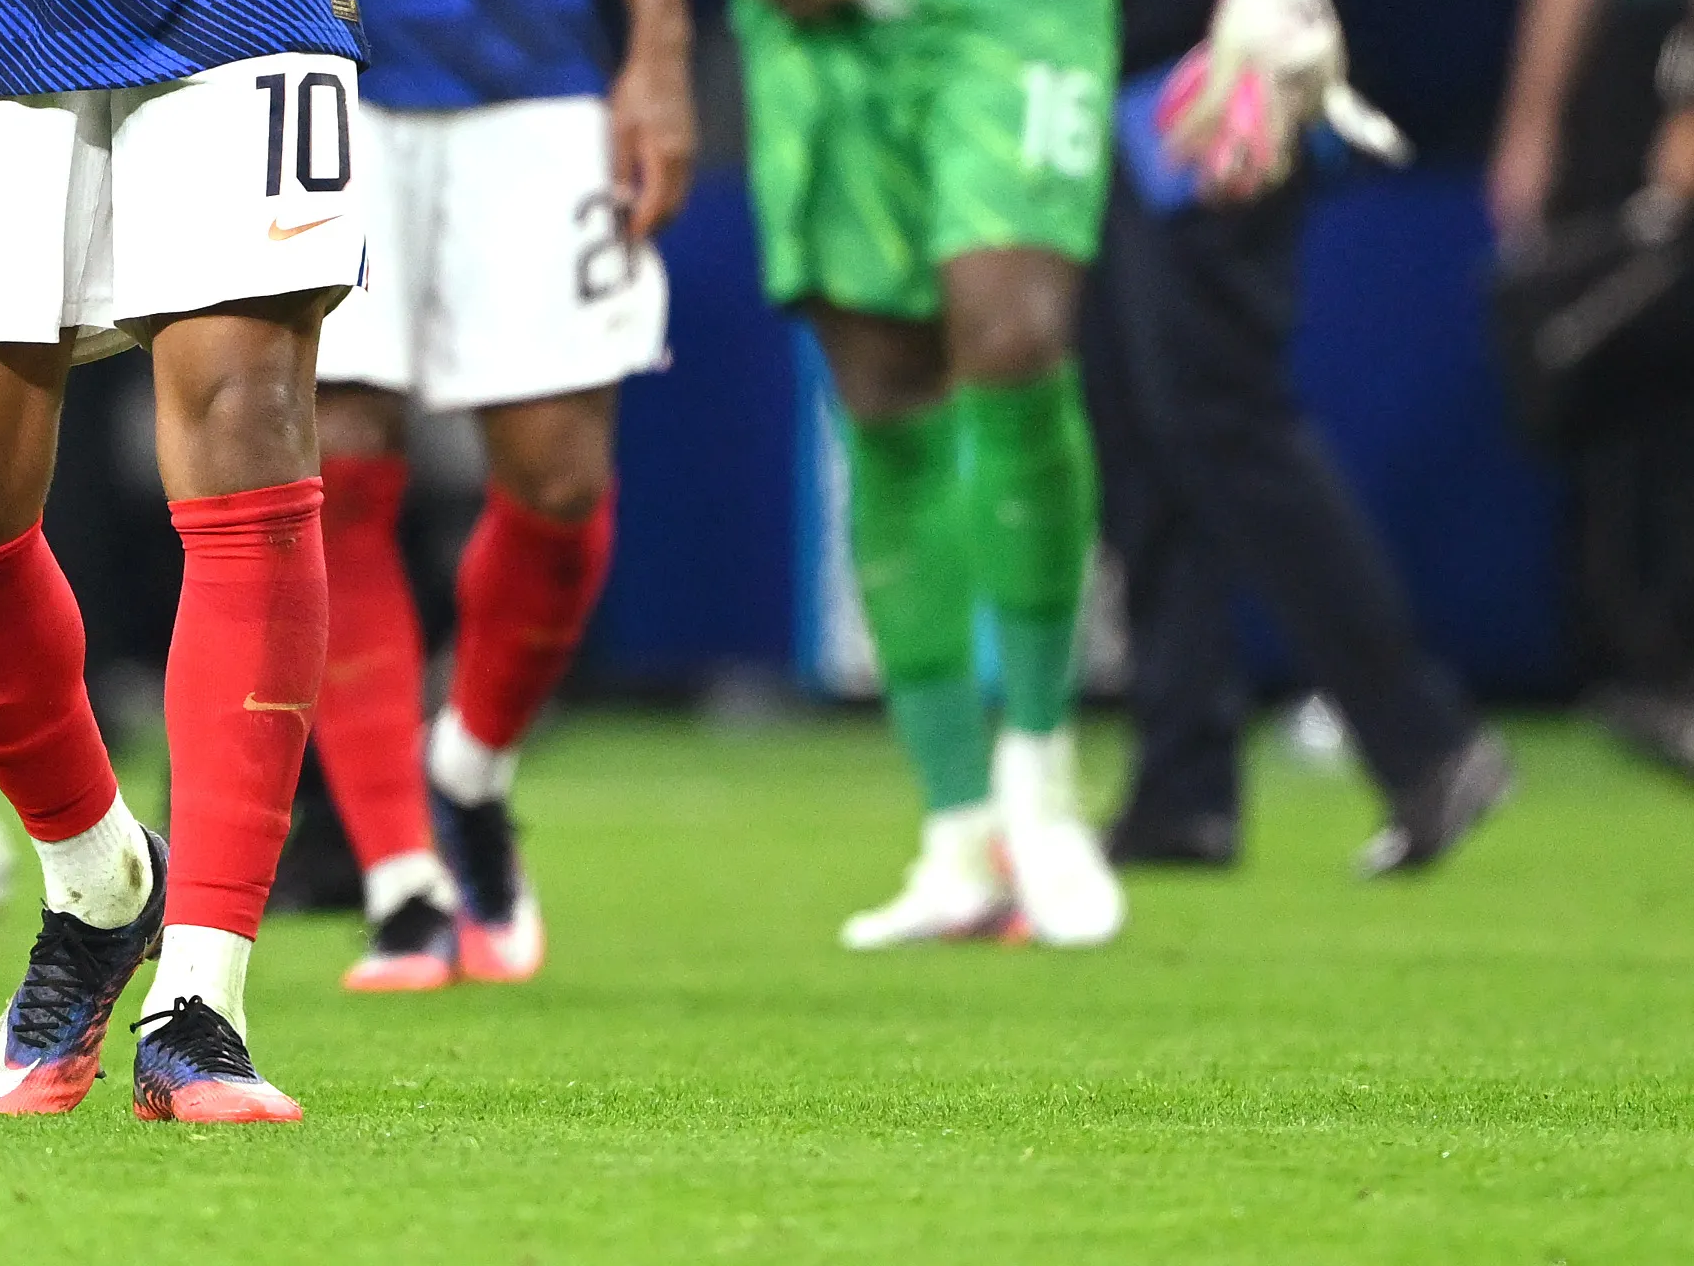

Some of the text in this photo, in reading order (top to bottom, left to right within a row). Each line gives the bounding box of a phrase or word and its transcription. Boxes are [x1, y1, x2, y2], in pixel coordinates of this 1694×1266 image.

[256, 72, 351, 196] 10
[1019, 62, 1101, 174] 16
[572, 191, 636, 305] 2
